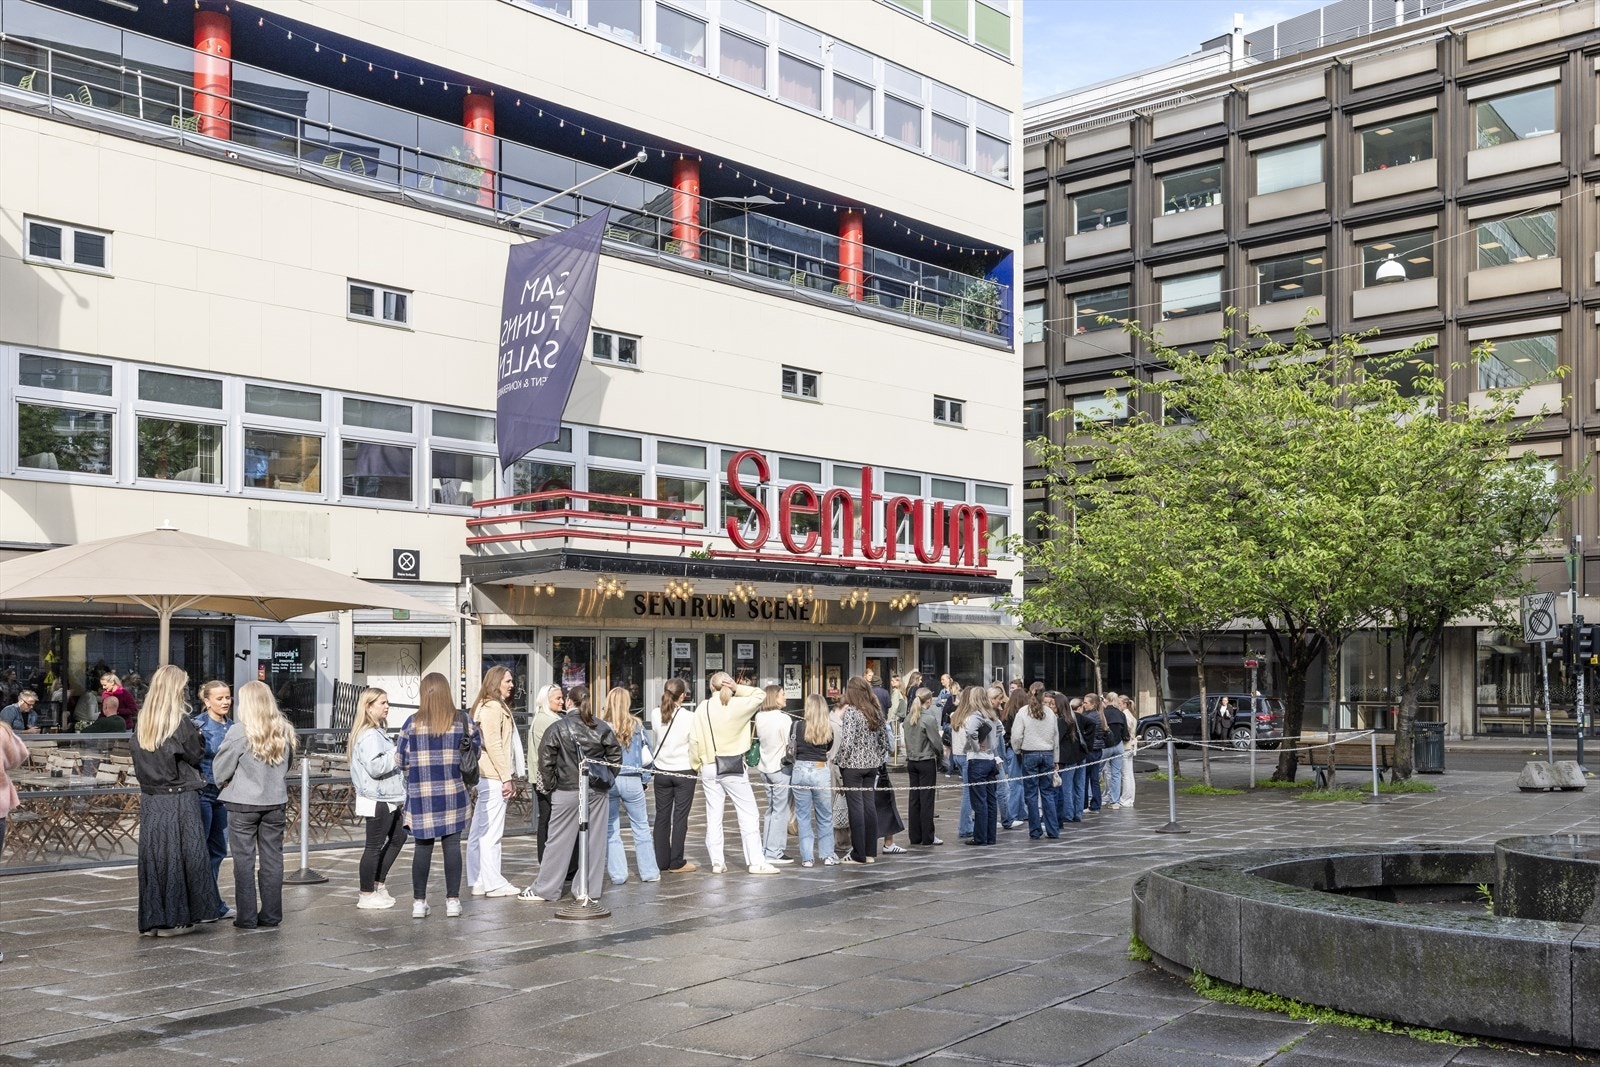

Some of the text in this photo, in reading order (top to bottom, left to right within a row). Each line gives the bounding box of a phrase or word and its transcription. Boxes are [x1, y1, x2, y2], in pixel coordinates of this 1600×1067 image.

[727, 450, 988, 568] Sentrum
[634, 594, 810, 621] SENTRUM SCENE
